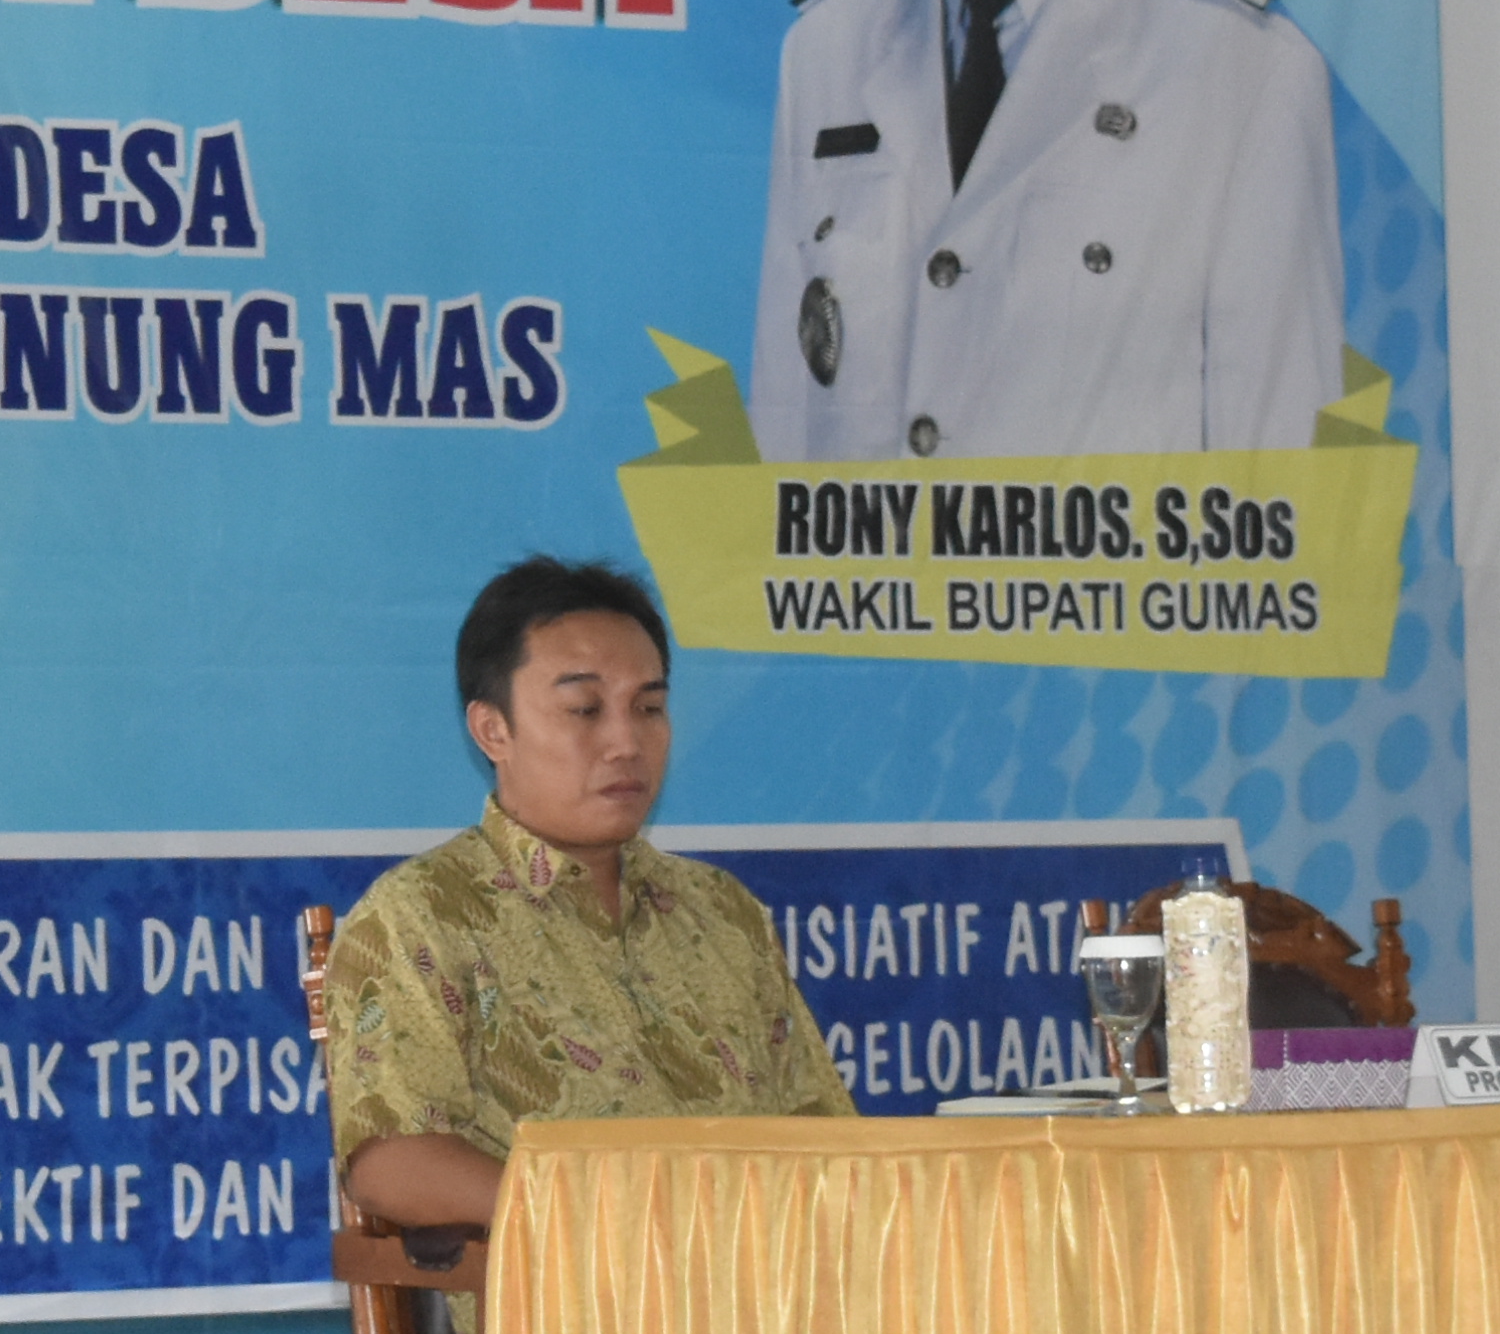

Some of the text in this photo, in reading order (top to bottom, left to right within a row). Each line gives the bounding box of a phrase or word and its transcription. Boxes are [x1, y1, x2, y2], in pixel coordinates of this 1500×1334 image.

[326, 291, 566, 430] MAS
[775, 481, 1297, 567] RONY KARLOS. S,Sos
[765, 580, 1320, 634] WAKIL BUPATI GUMAS
[141, 914, 263, 997] DAN
[768, 903, 981, 981] ISIATIF
[172, 1158, 295, 1241] DAN
